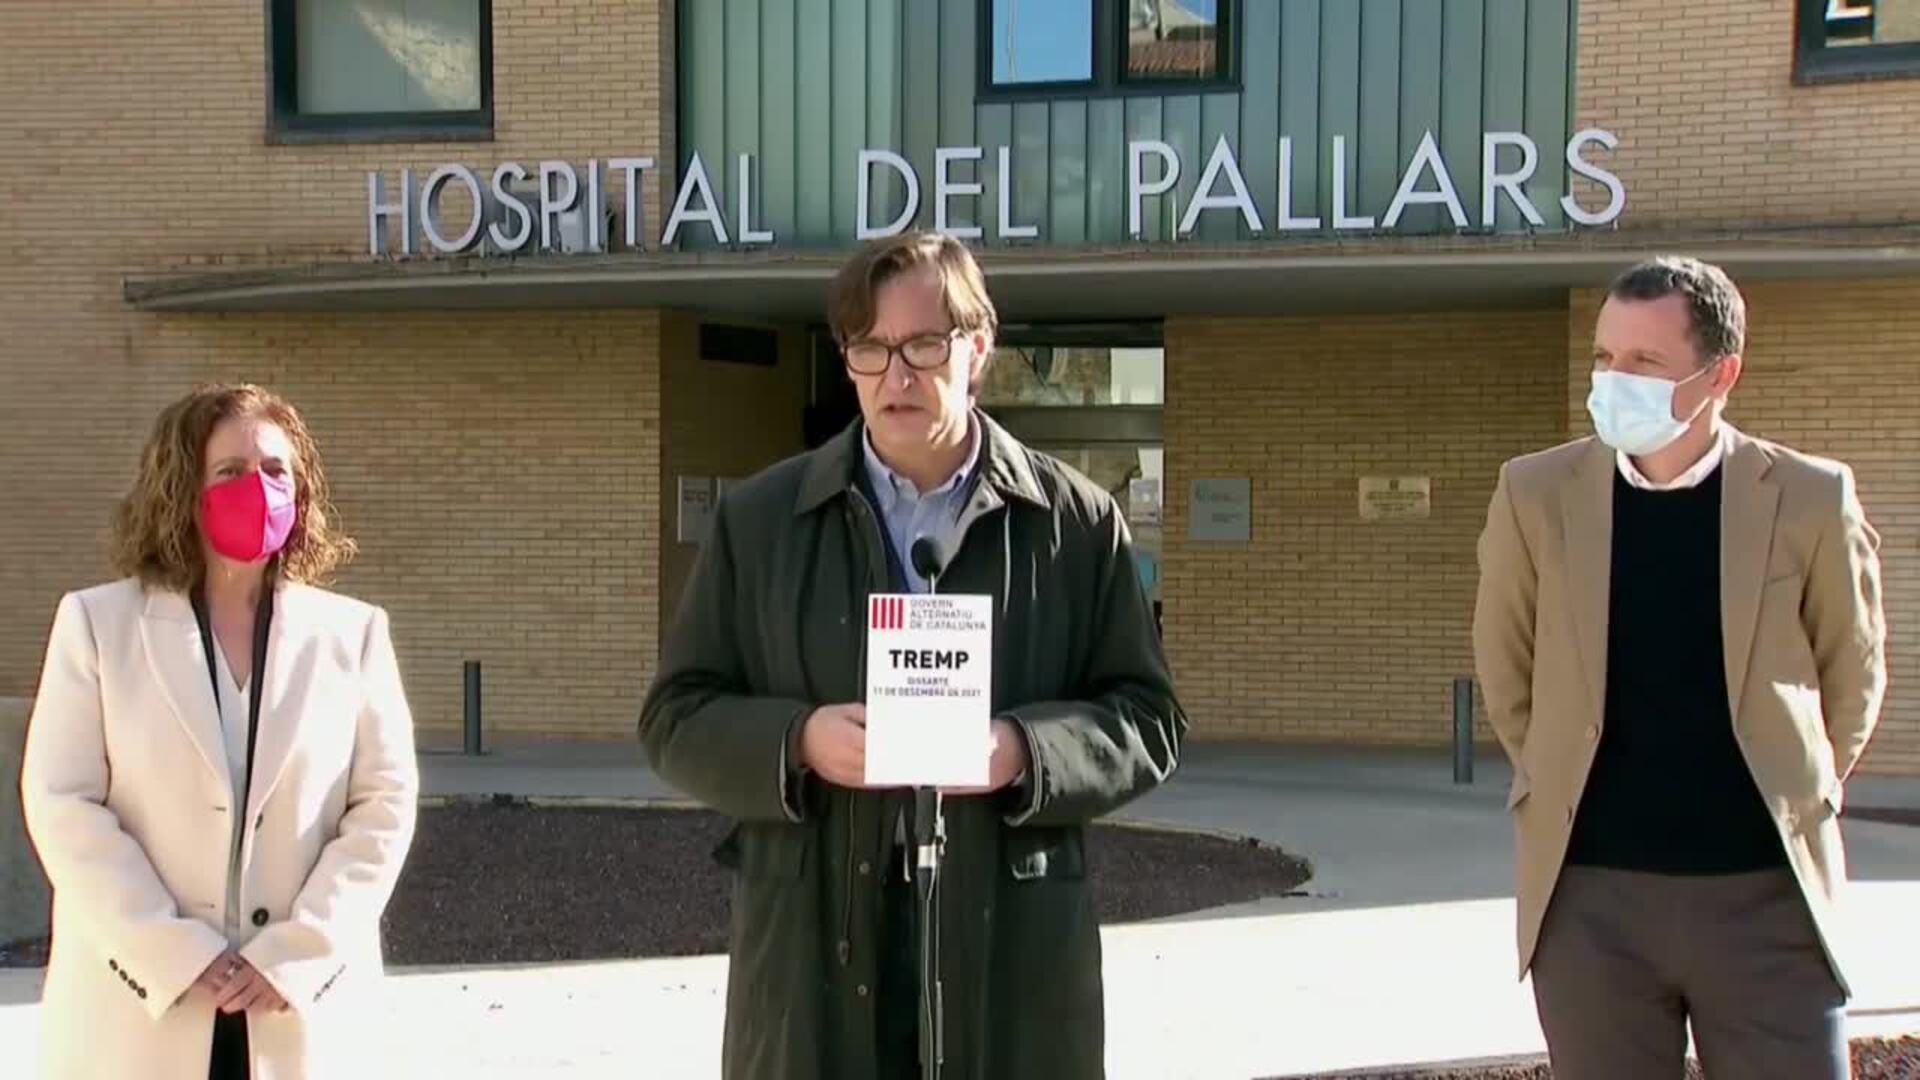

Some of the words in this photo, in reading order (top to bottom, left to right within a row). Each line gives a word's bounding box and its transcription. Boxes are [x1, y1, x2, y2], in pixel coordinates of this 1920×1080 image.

[368, 150, 773, 255] HOSPITAL
[856, 145, 1039, 240] DEL
[1128, 128, 1626, 235] PALLARS
[910, 599, 953, 608] GOVERN
[910, 610, 973, 619] ALTERNATIU
[910, 621, 922, 630] DE
[926, 621, 986, 630] CATALUNYA
[888, 649, 969, 670] TREMP
[907, 677, 949, 685] DISSABTE
[873, 687, 883, 696] 11
[885, 687, 896, 696] DE
[898, 687, 945, 697] DESEMBRE
[947, 688, 959, 697] DE
[961, 688, 981, 697] 2021
